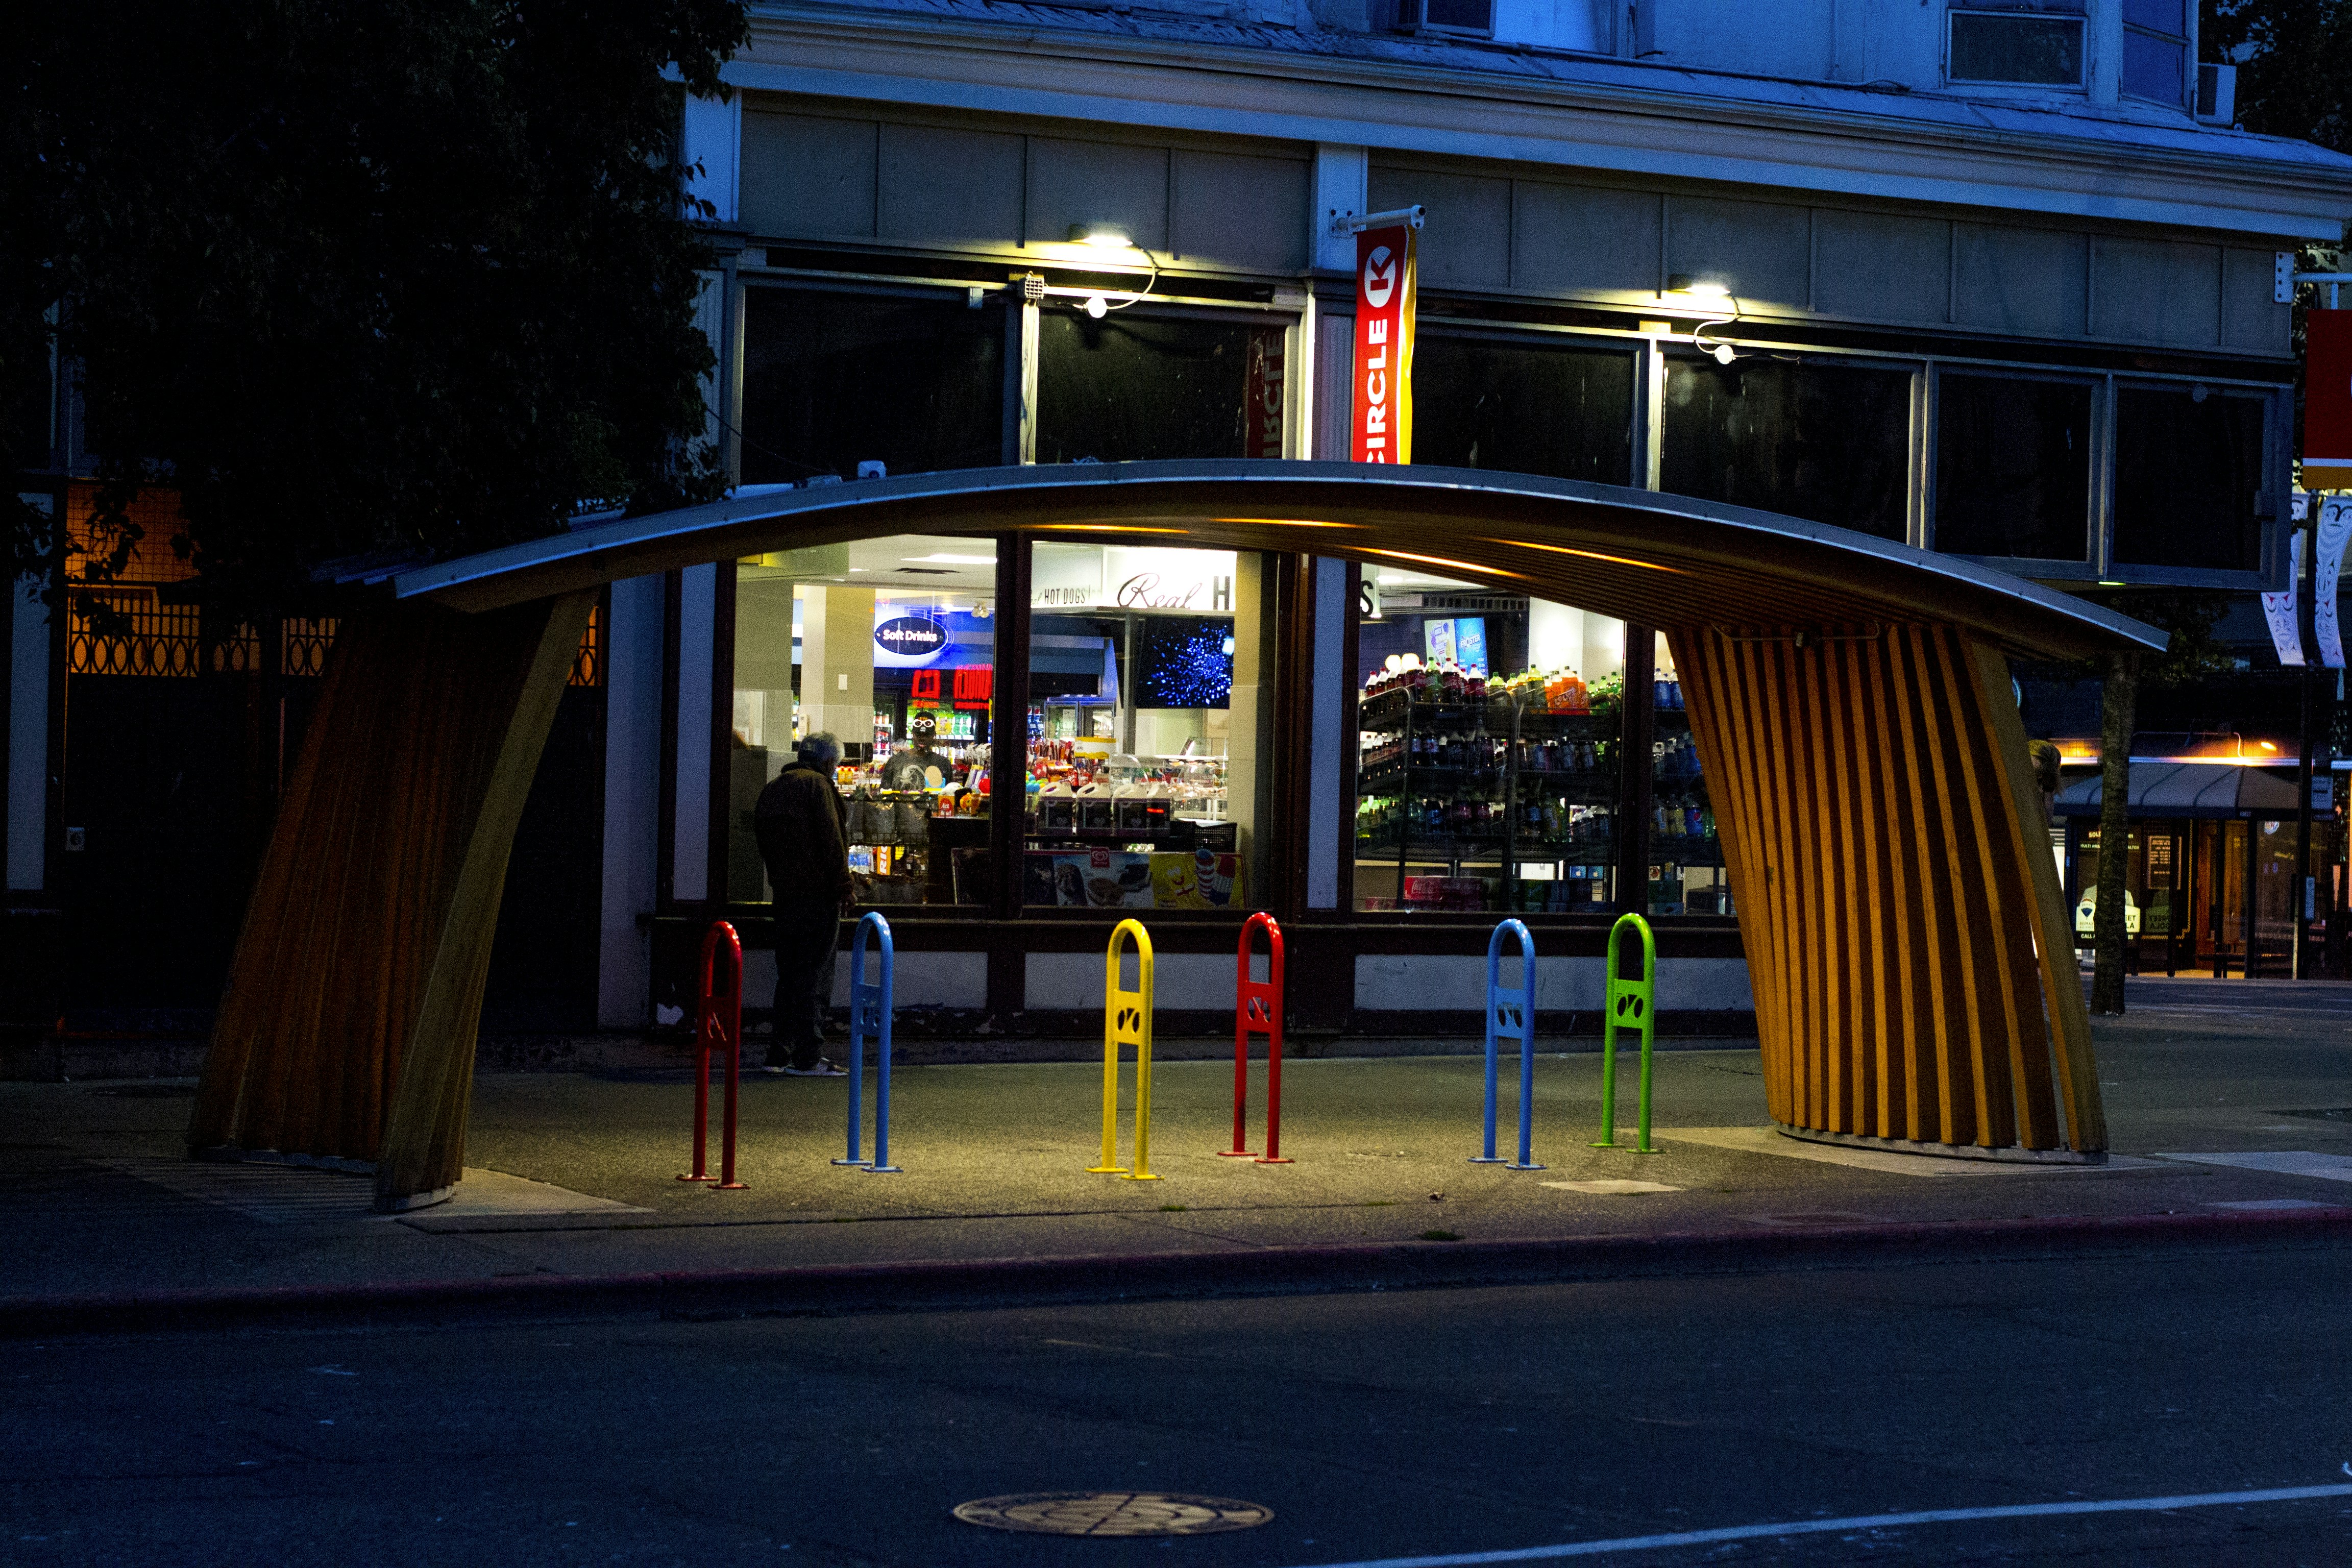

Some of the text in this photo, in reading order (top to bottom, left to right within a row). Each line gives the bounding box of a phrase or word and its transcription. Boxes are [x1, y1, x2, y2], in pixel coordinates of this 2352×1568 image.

[1044, 589, 1060, 605] HOT
[1063, 587, 1086, 604] DOGS
[1117, 573, 1203, 609] Real
[883, 629, 938, 643] Soft Drinks
